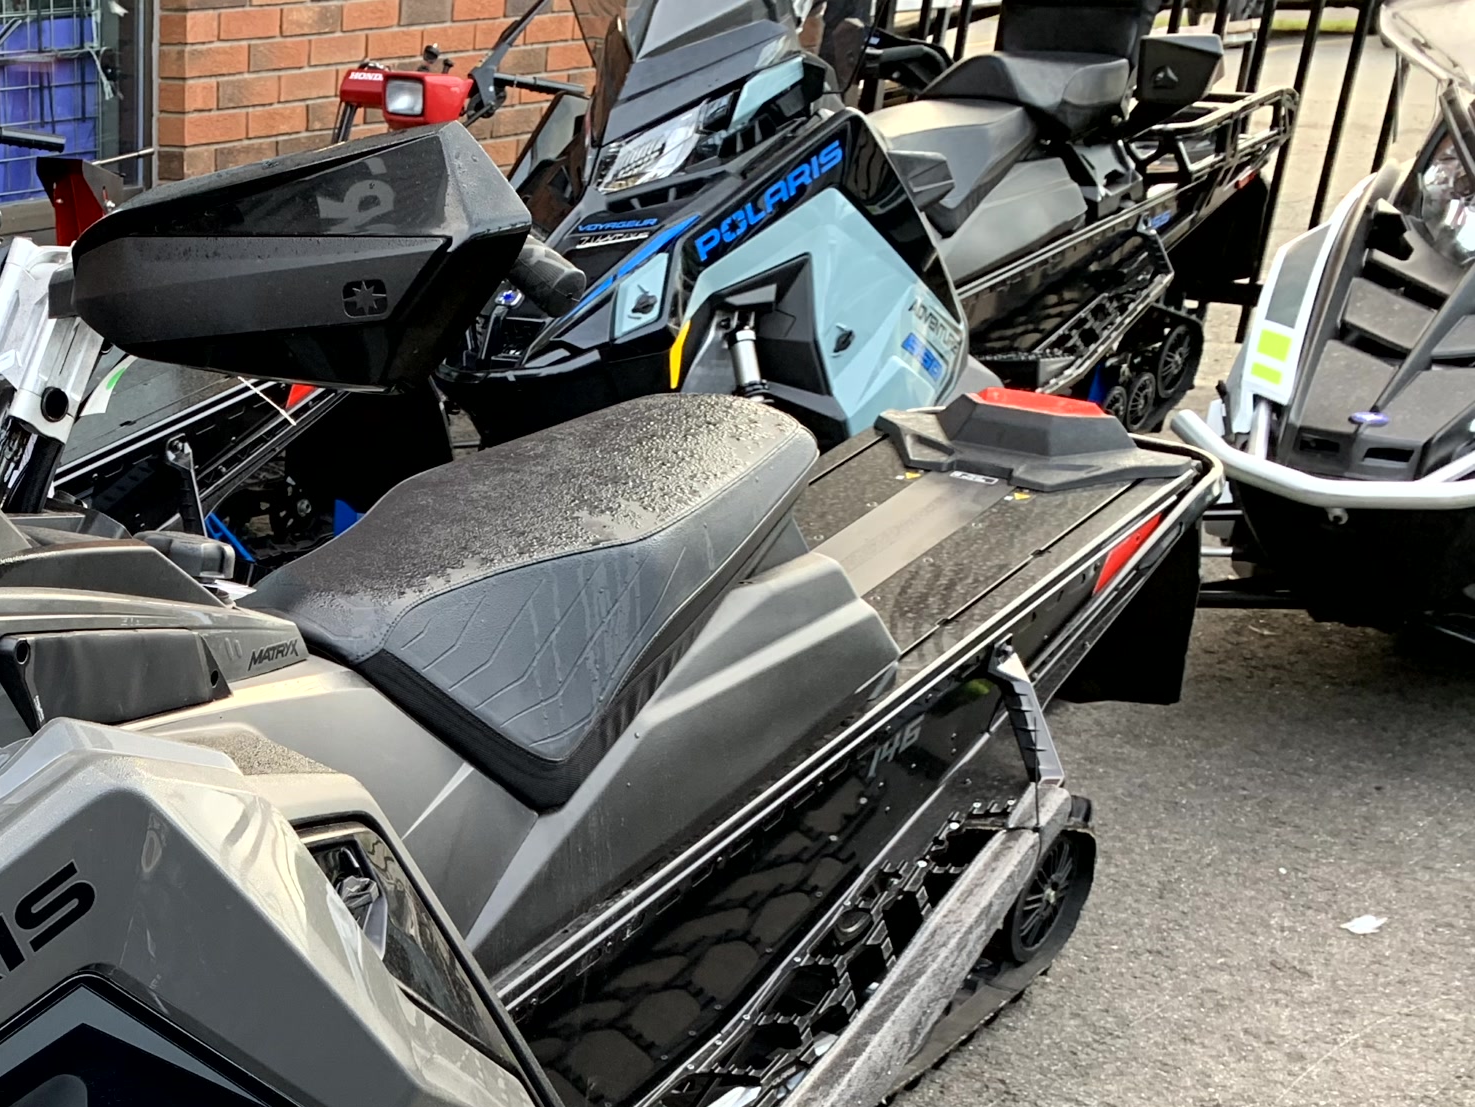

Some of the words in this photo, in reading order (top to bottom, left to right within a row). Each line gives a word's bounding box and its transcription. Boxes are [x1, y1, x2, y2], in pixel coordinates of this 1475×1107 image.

[694, 139, 844, 262] POLARIS
[577, 218, 658, 232] VOYAGEUR
[247, 638, 299, 672] MATRYX
